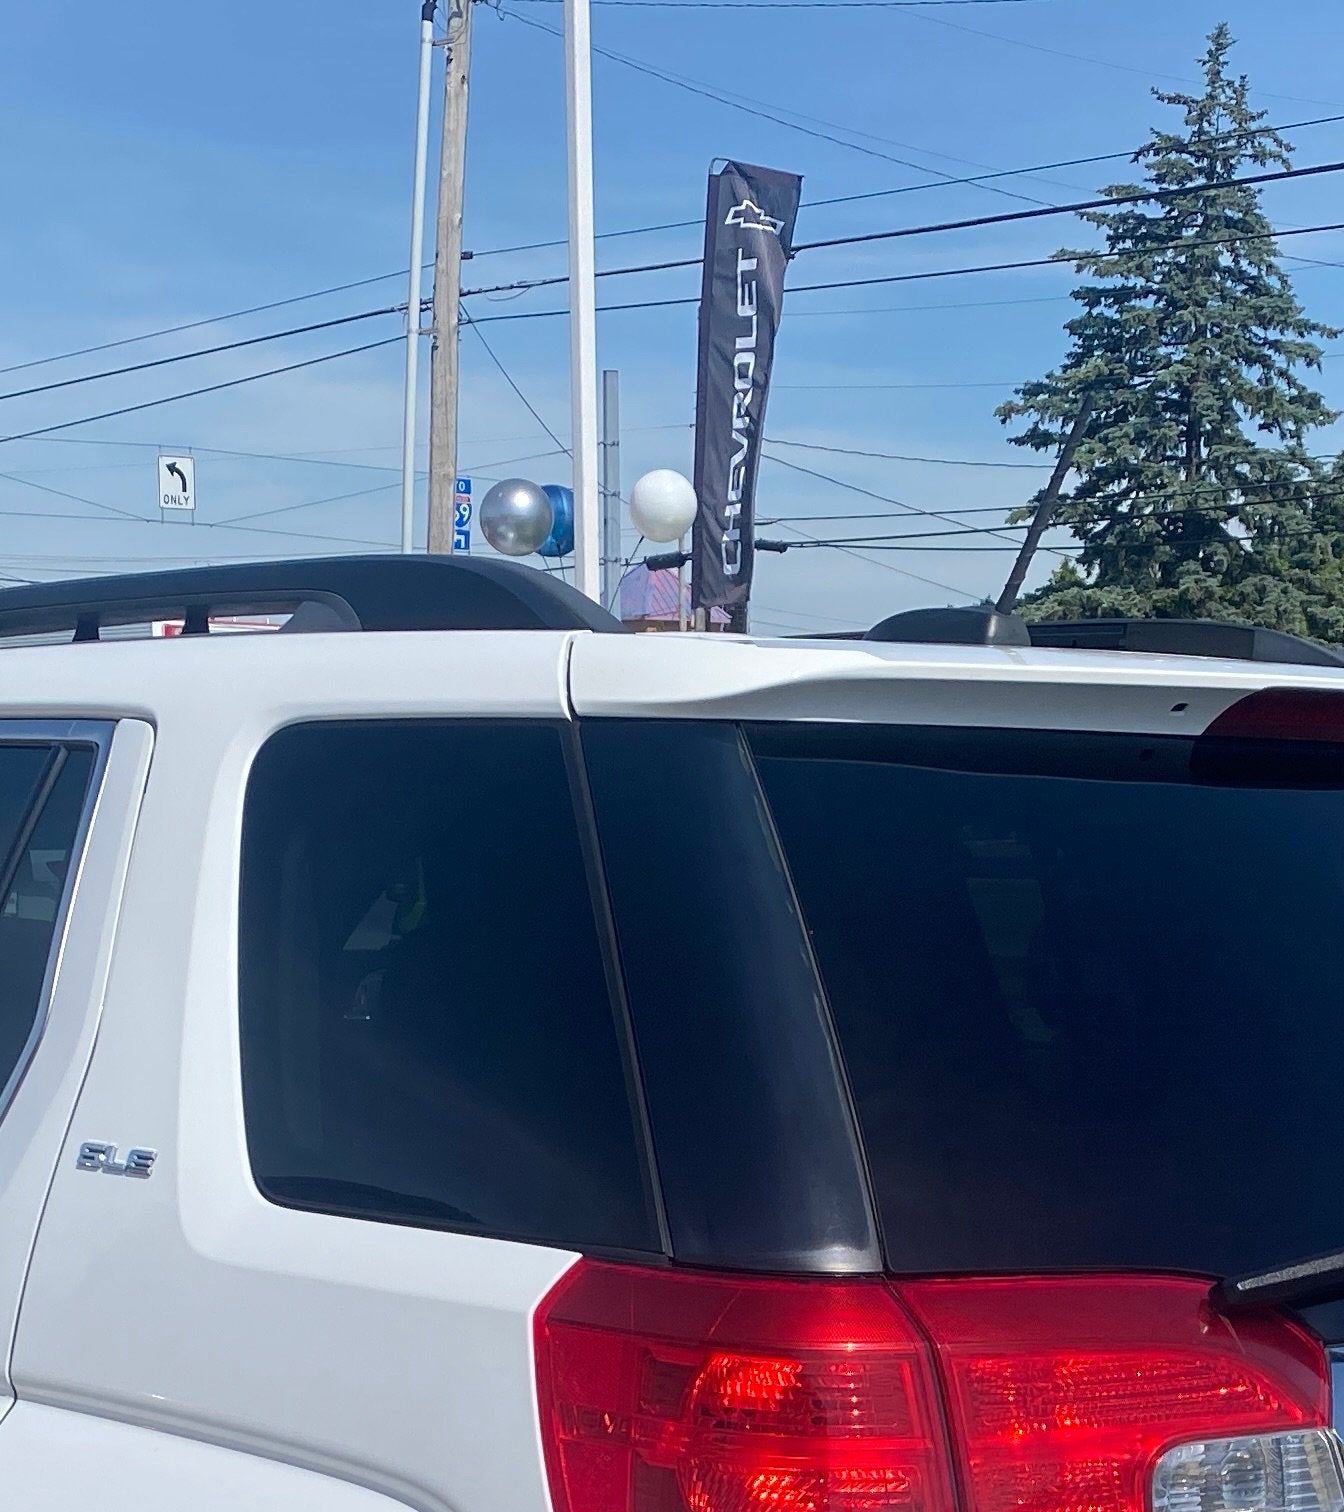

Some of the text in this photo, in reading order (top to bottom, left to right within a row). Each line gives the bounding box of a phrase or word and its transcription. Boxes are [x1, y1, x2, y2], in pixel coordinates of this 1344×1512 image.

[721, 246, 758, 577] CHEVROLET
[163, 494, 190, 506] ONLY
[76, 1142, 157, 1179] SLE
